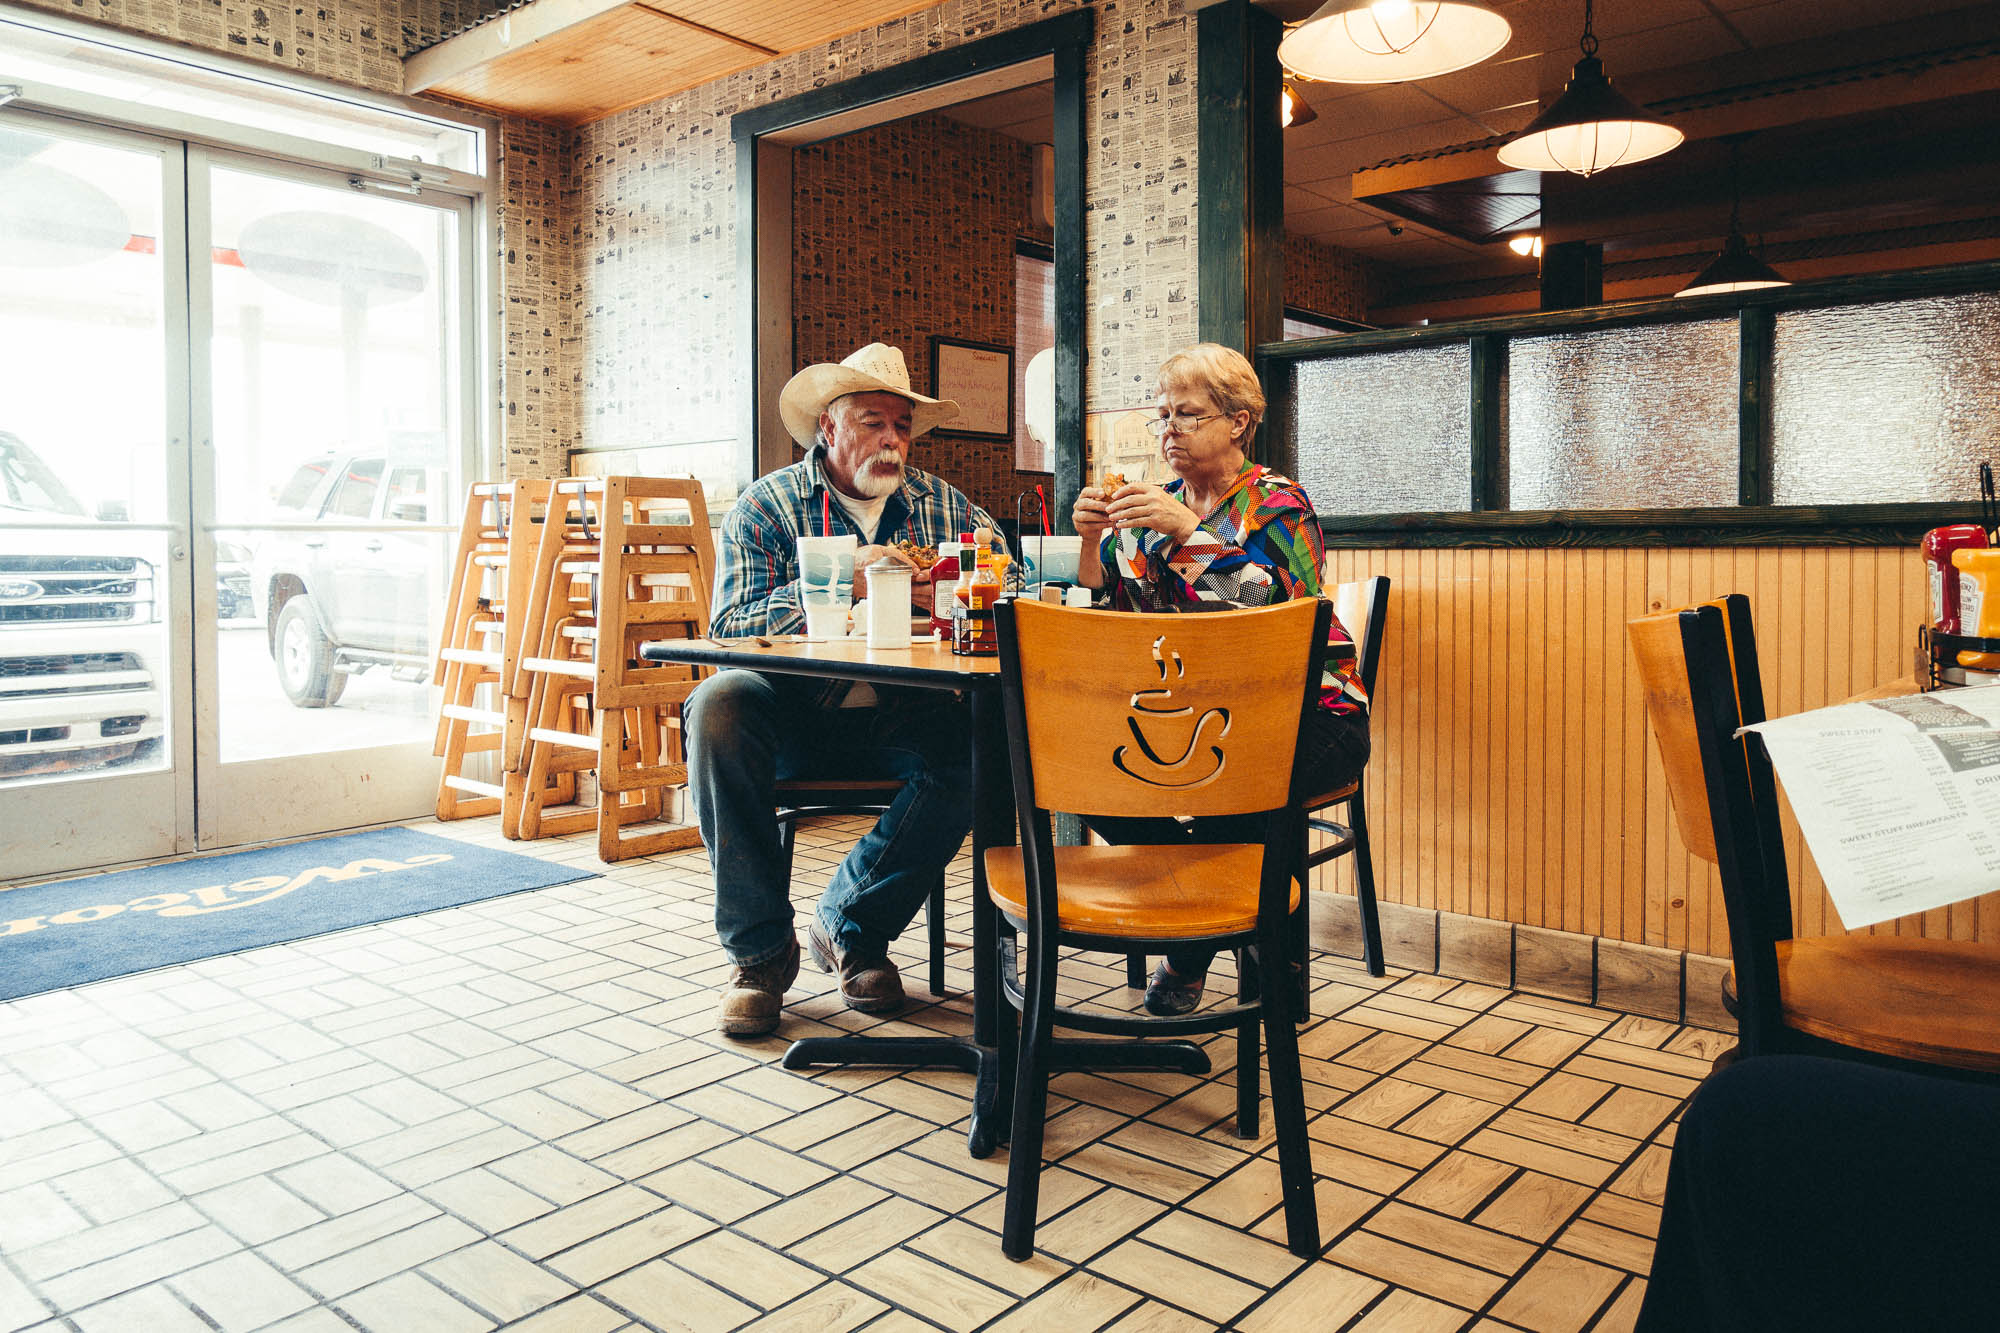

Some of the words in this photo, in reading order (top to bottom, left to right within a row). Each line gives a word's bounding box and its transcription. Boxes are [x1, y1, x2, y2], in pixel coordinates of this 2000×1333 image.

[1840, 832, 1873, 844] SWEET
[1874, 825, 1904, 837] STUFF
[0, 853, 455, 938] Welco
